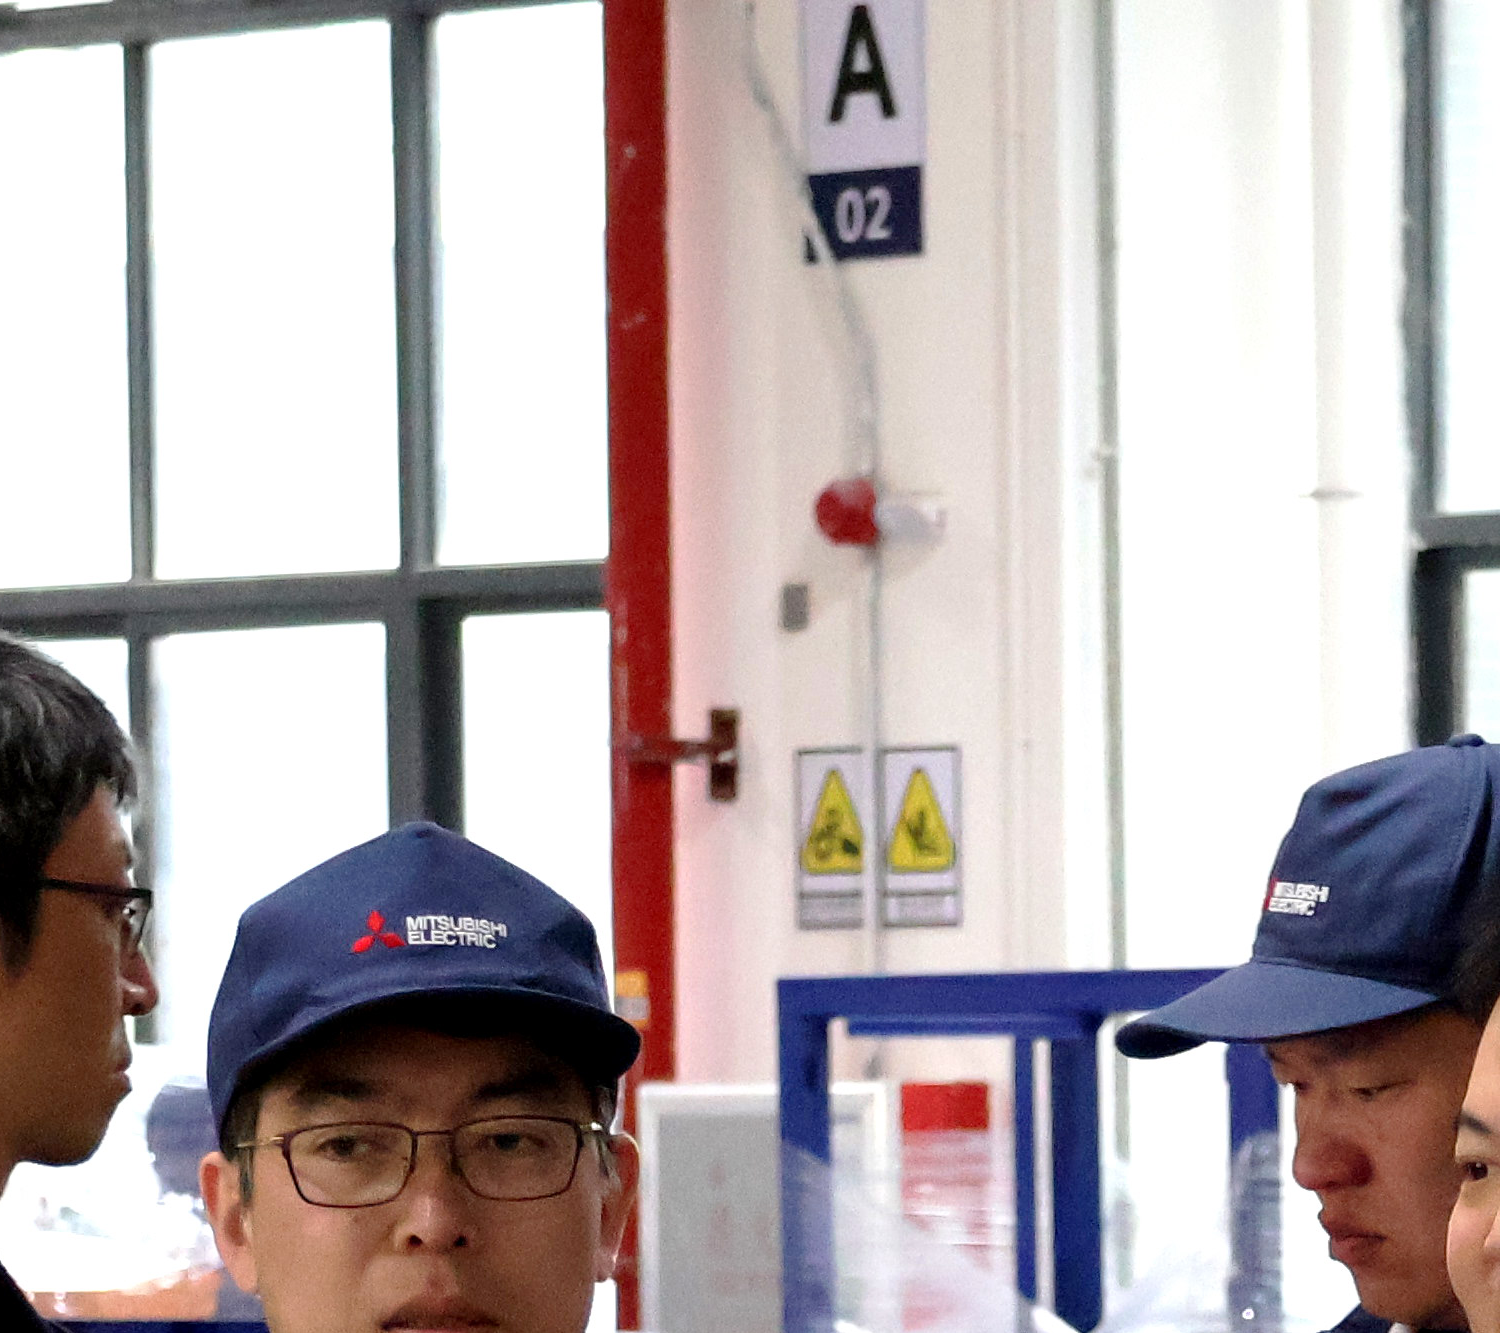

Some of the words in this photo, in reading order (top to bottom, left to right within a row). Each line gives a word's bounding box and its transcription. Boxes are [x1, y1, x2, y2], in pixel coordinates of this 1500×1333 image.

[828, 4, 897, 123] A
[834, 184, 893, 244] 02
[405, 915, 508, 938] MITSUBISHI
[406, 931, 497, 949] ELECTRIC
